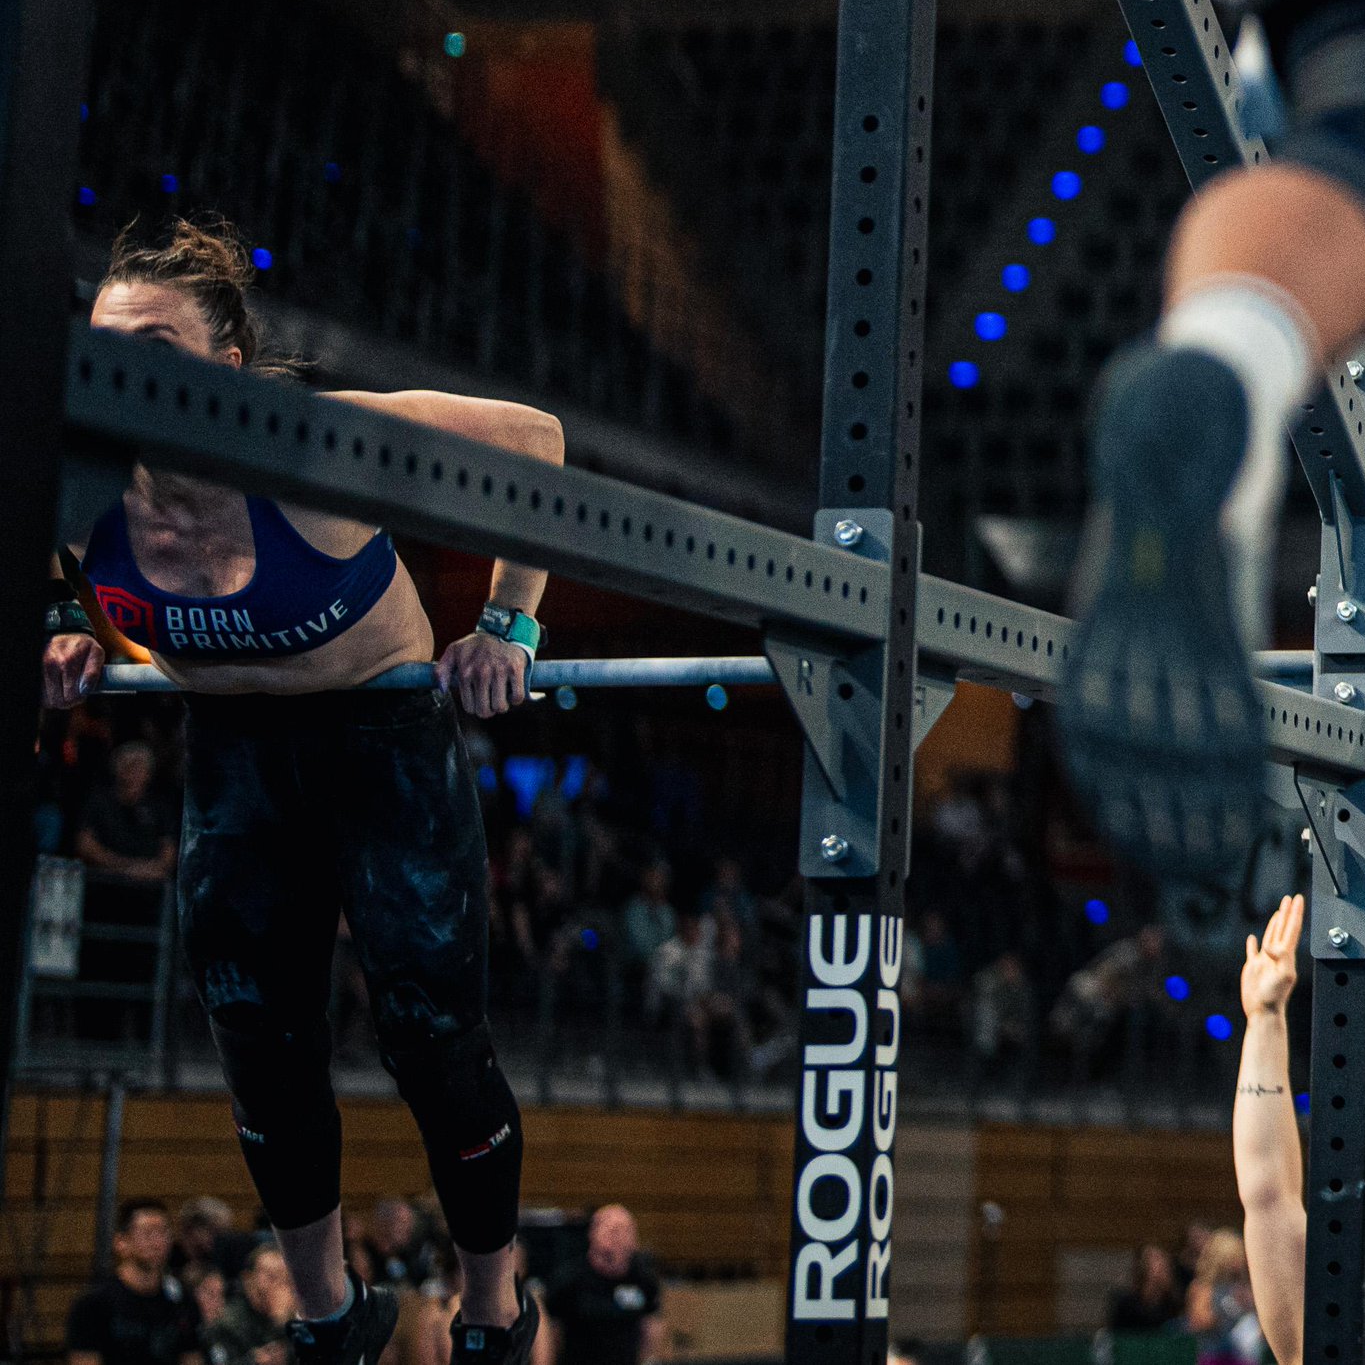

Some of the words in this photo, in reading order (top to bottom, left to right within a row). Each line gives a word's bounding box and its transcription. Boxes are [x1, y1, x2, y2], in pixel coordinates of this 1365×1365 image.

[165, 606, 255, 632] BORN
[168, 598, 348, 650] PRIMITIVE
[793, 914, 871, 1320] ROGUE
[865, 915, 904, 1318] ROGUE
